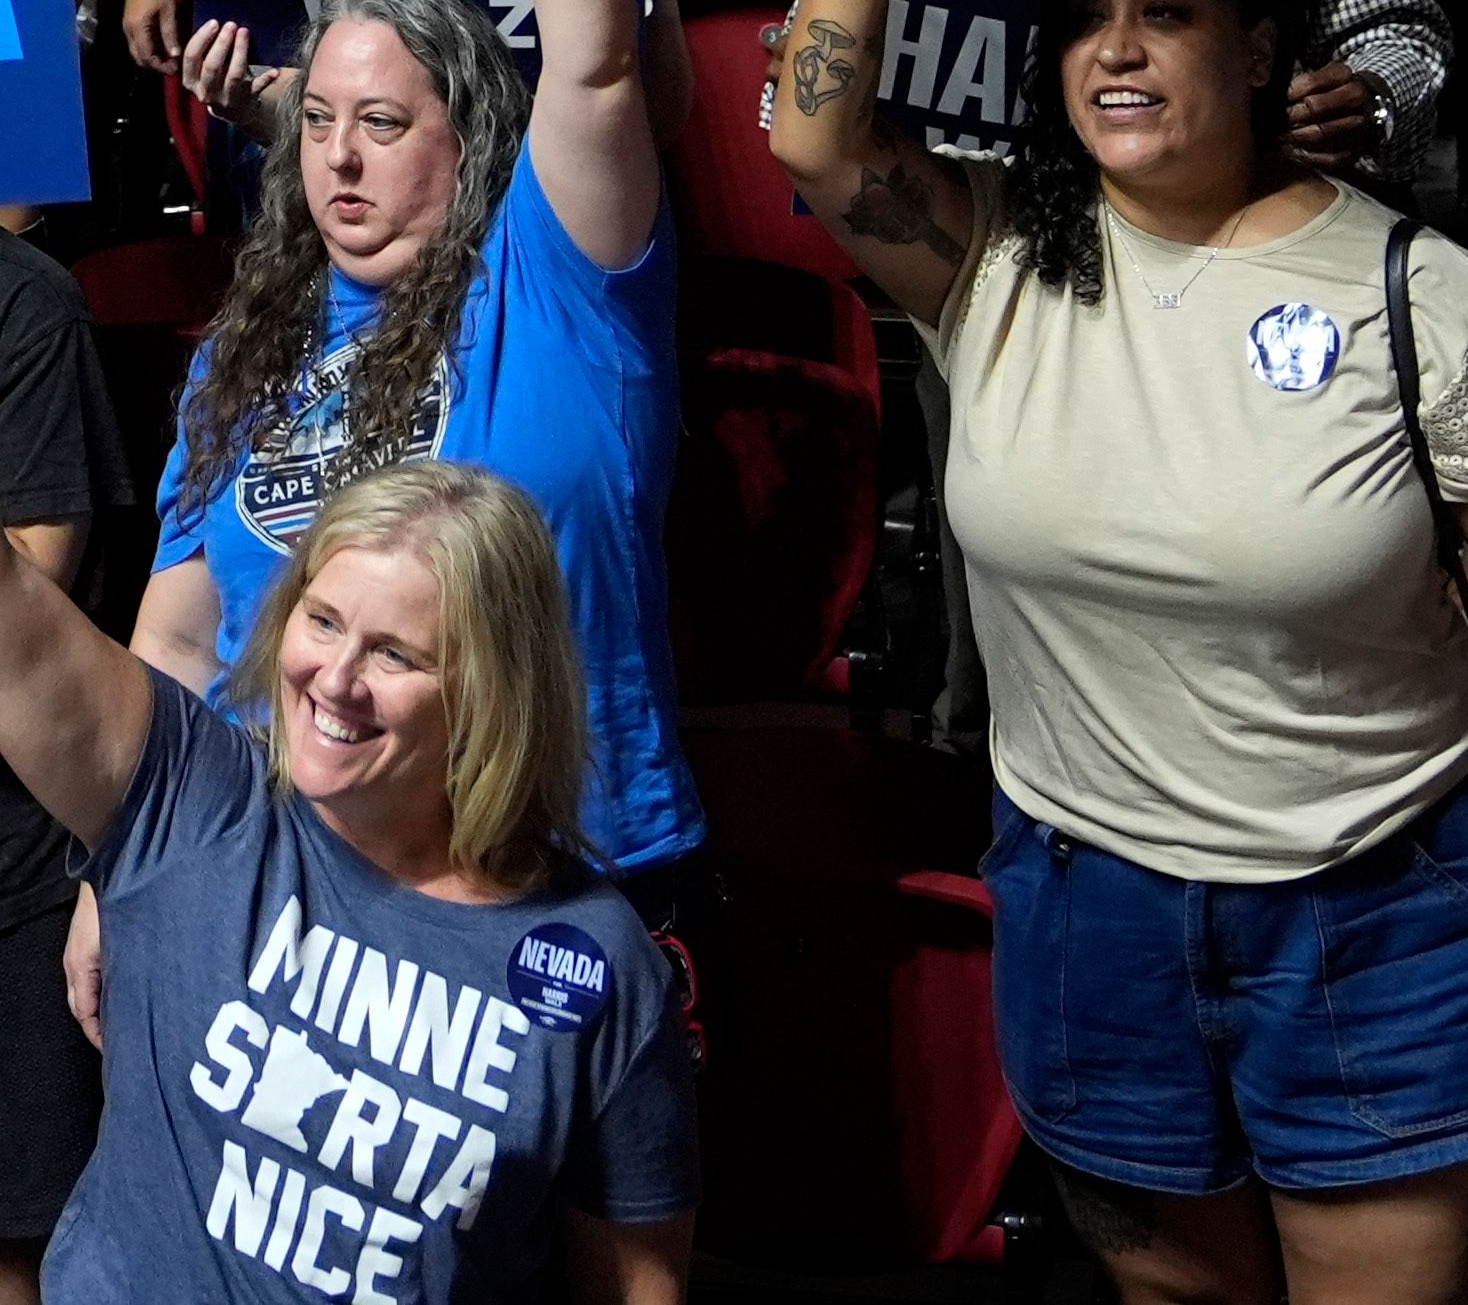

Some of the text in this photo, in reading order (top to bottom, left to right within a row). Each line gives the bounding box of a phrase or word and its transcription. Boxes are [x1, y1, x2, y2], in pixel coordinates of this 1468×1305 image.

[252, 477, 315, 505] CAPE
[248, 894, 531, 1113] MINNE
[518, 936, 605, 993] NEVADA
[205, 1143, 423, 1305] NICE
